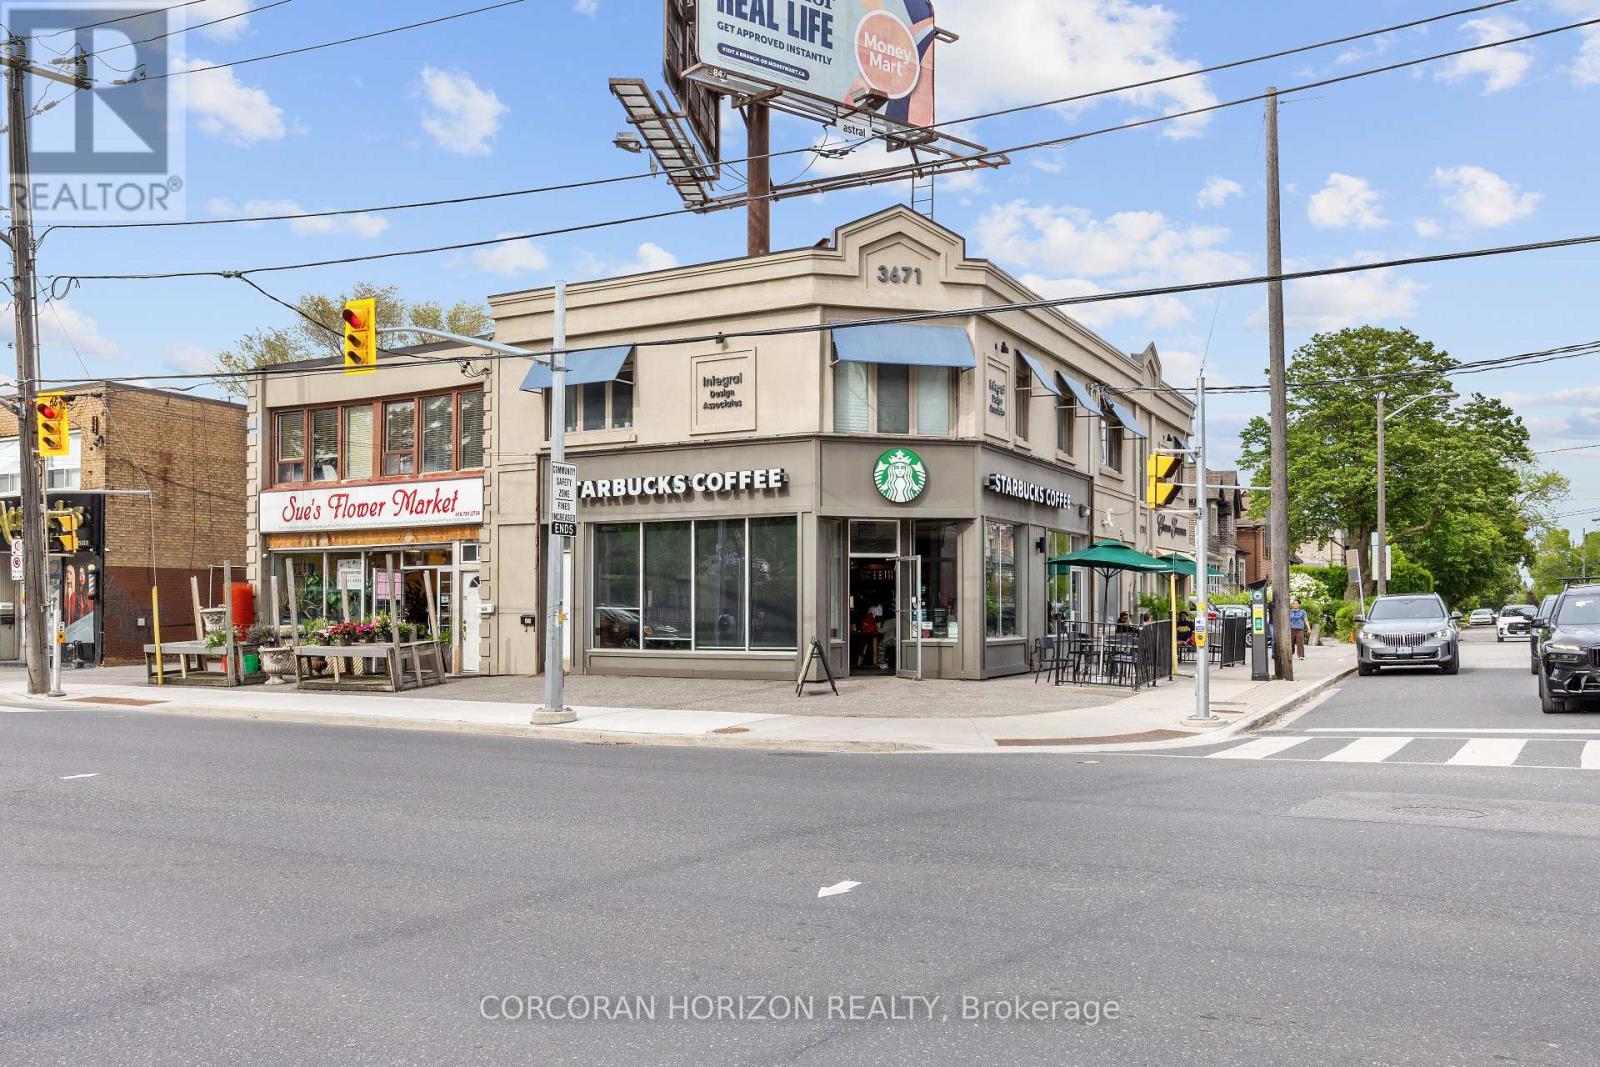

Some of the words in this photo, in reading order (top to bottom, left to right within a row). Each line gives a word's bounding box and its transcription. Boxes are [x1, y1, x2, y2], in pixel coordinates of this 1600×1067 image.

[787, 1, 833, 49] LIFE
[717, 21, 735, 34] GET
[736, 27, 785, 50] APPROVED
[786, 44, 832, 66] INSTANTLY
[864, 31, 912, 63] Money
[869, 51, 903, 76] Mart
[843, 124, 866, 138] astral
[877, 264, 922, 286] 3671
[703, 372, 743, 388] Integral
[709, 389, 736, 399] Design
[556, 477, 573, 487] SAFETY
[577, 474, 686, 498] ARBUCKS
[692, 468, 782, 492] COFFEE
[995, 473, 1044, 503] STARBUCKS
[1046, 489, 1071, 510] COFFEE
[558, 489, 570, 498] ZONE
[281, 495, 321, 523] Sue's
[327, 493, 386, 519] Flower
[392, 487, 459, 517] Market
[557, 502, 571, 510] FINES
[554, 523, 574, 535] ENDS
